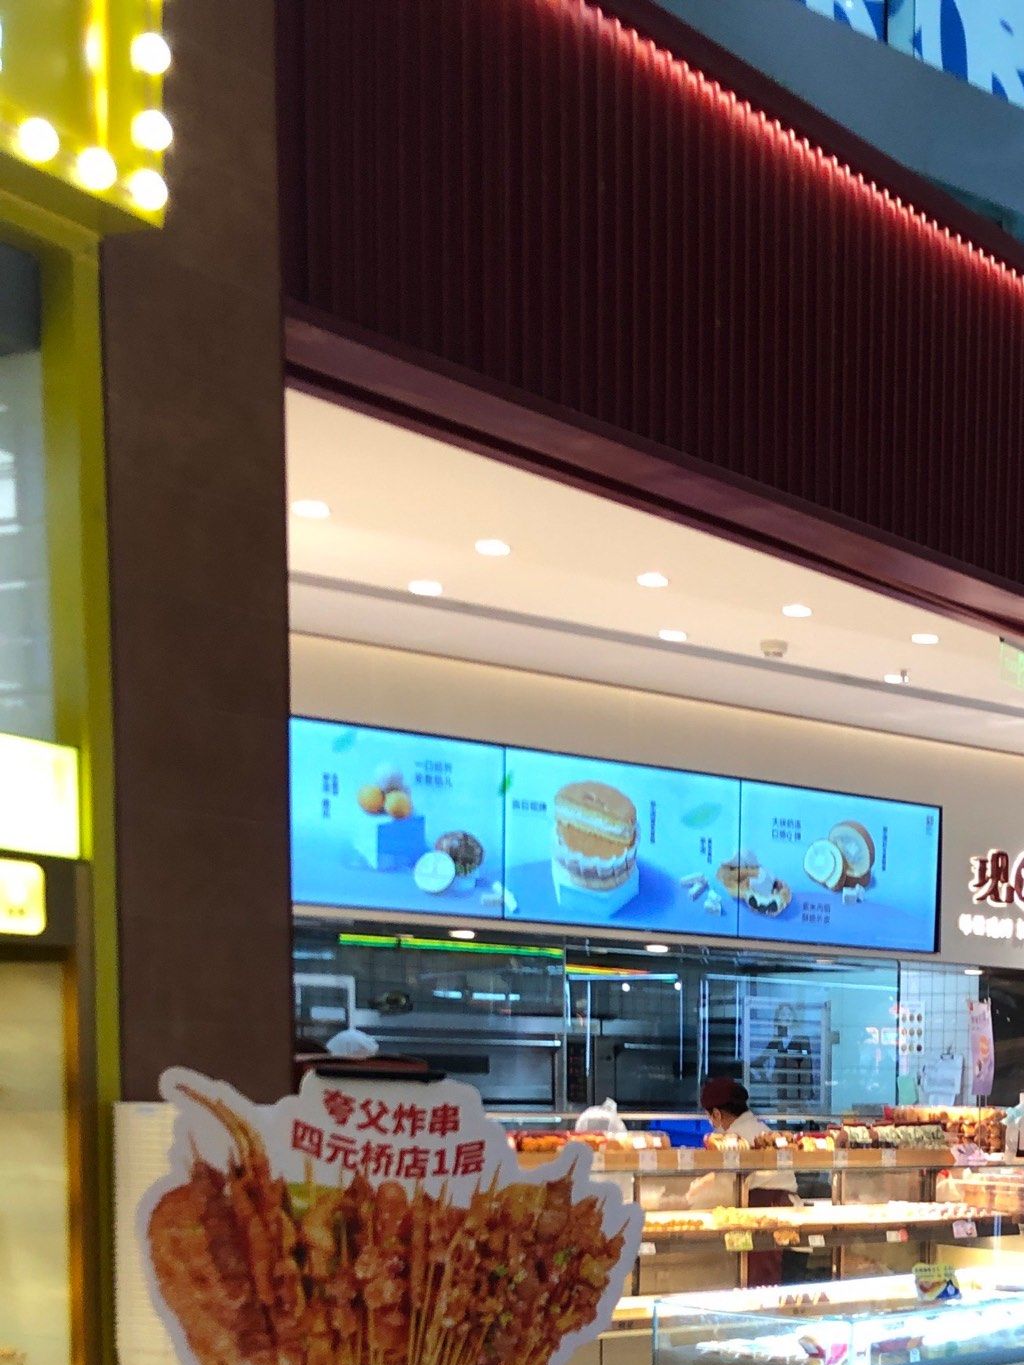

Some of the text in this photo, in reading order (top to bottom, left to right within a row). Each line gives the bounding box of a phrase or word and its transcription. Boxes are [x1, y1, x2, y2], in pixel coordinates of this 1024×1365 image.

[323, 1088, 461, 1138] 夸父炸串
[292, 1118, 486, 1179] 四元桥店1层
